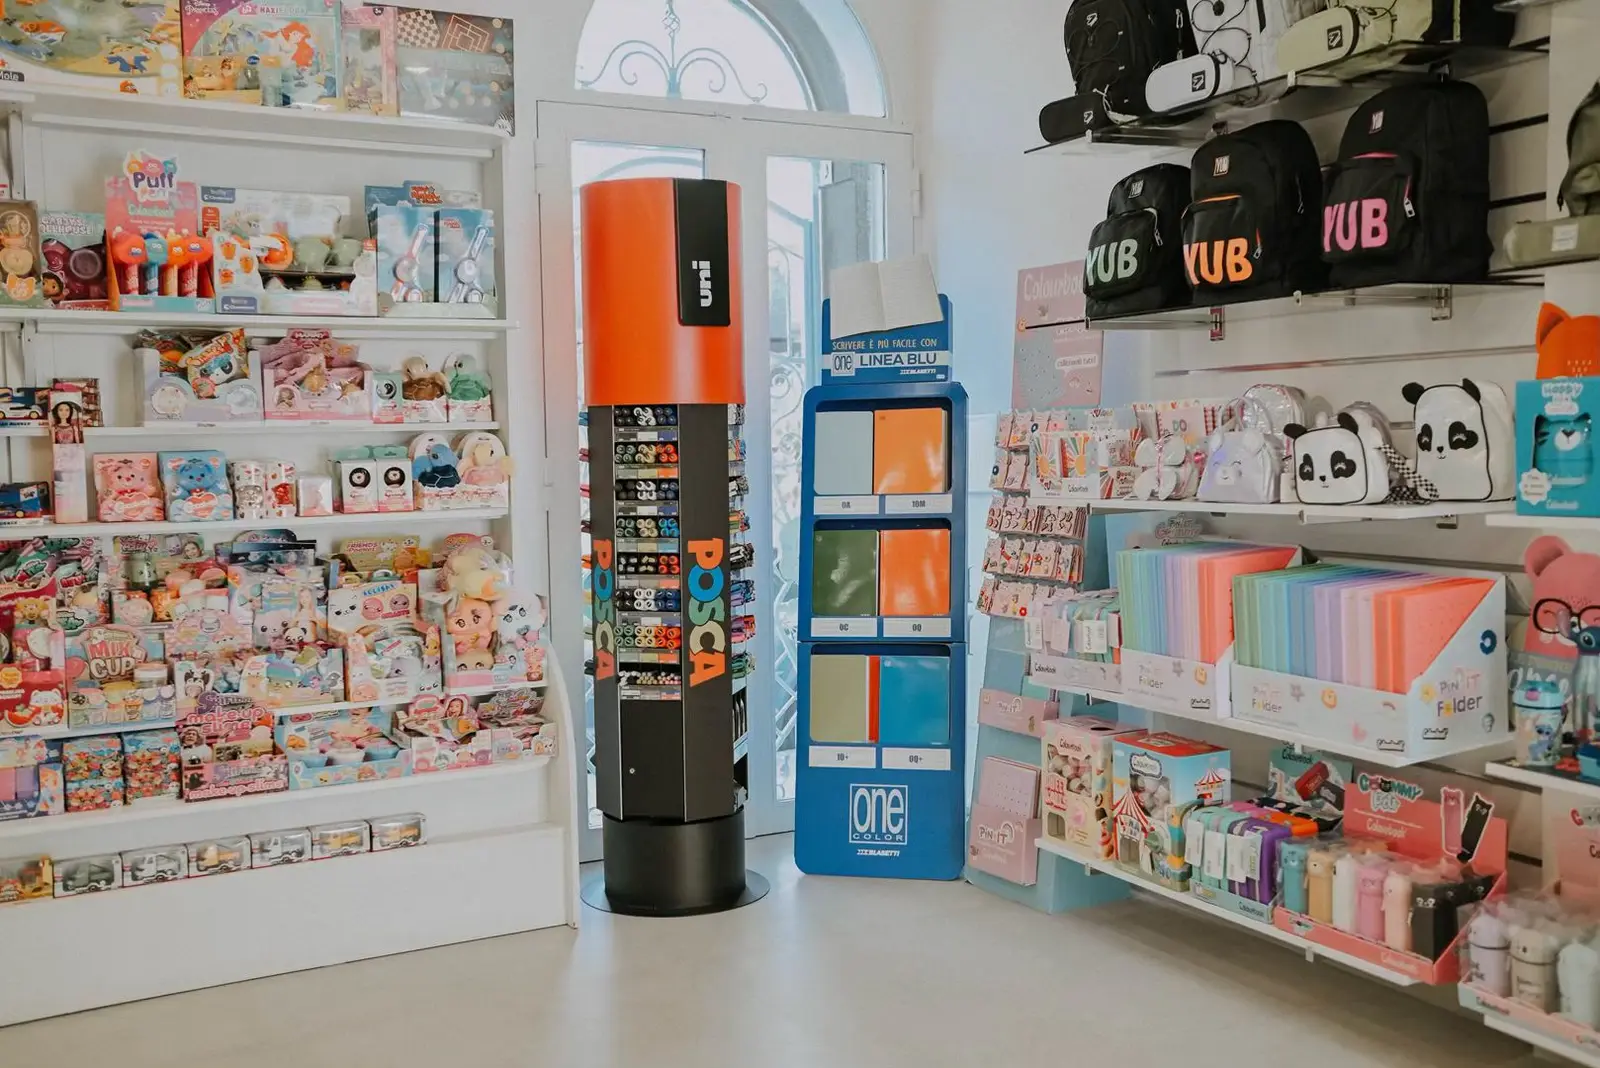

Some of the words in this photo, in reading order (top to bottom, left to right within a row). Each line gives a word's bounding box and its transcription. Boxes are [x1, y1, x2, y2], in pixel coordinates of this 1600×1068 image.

[132, 171, 175, 189] Puff
[1323, 197, 1388, 252] YUB
[692, 260, 712, 307] uni
[1085, 238, 1139, 286] YUB
[1183, 237, 1253, 286] YUB
[1024, 270, 1085, 301] Colourbo
[832, 340, 866, 350] SCRIVERE
[869, 338, 874, 349] È
[877, 338, 889, 349] PIÙ
[892, 338, 917, 348] FACILE
[920, 338, 938, 347] CON
[834, 355, 853, 371] one
[860, 353, 904, 366] LINEA
[907, 352, 937, 365] BLU
[593, 538, 615, 681] POSCA
[687, 537, 726, 688] POSCA
[89, 656, 136, 679] CUP
[853, 787, 905, 834] one
[852, 833, 904, 841] COLOR
